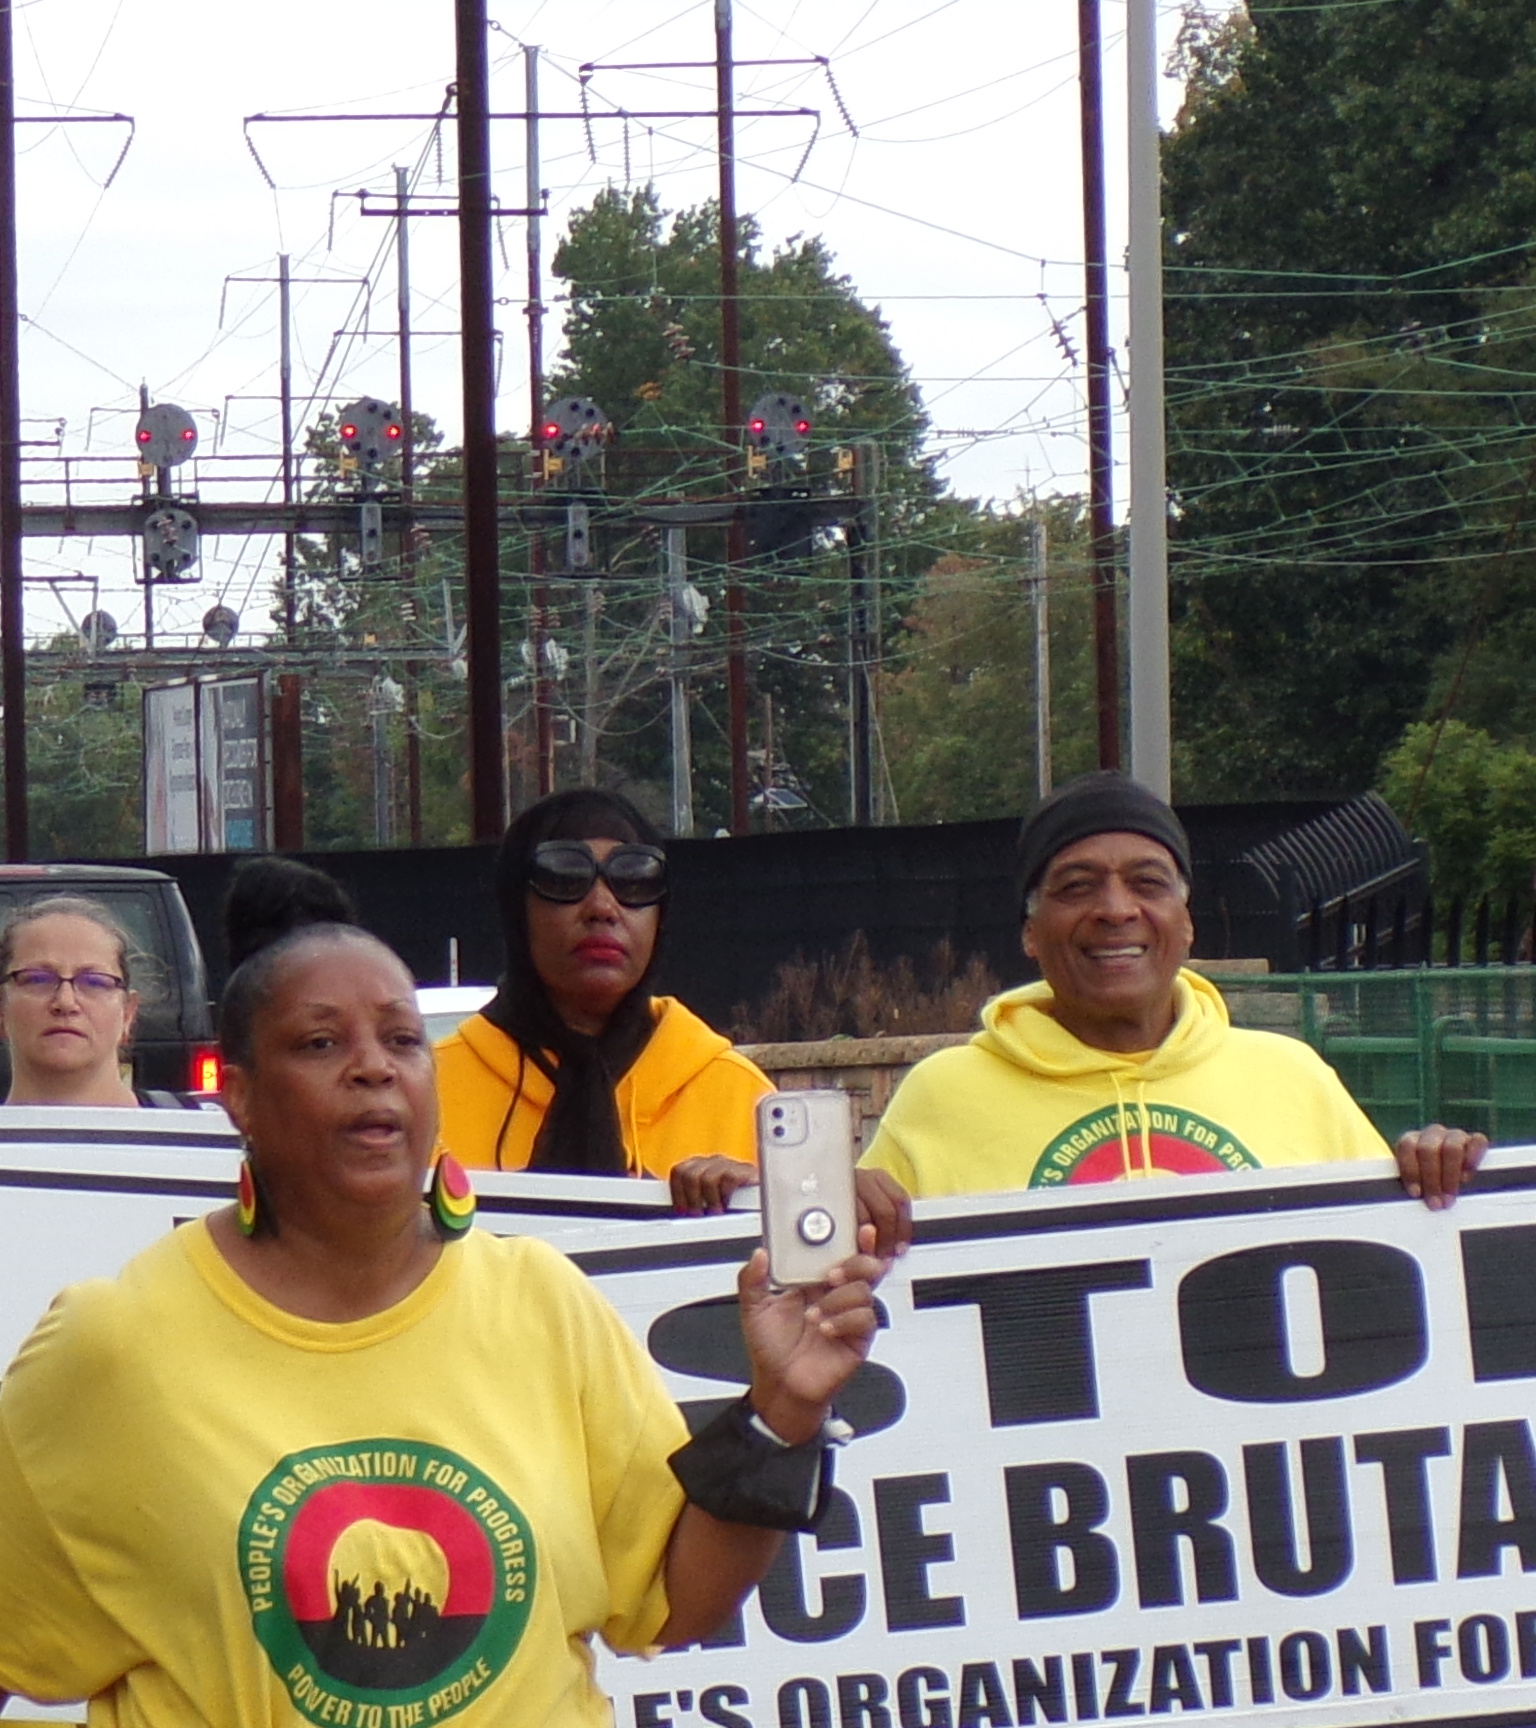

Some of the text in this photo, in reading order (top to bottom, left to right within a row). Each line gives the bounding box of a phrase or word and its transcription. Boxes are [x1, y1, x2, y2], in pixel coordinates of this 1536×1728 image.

[1038, 1167, 1064, 1190] 'S
[1052, 1110, 1178, 1167] ORGANIZAON
[1183, 1119, 1218, 1149] FOR
[248, 1450, 526, 1613] PEOPLE'S ORGANIZATION FOR PROGRESS
[700, 1471, 966, 1650] CE
[287, 1663, 353, 1726] POWER
[428, 1656, 492, 1719] PEOPLE
